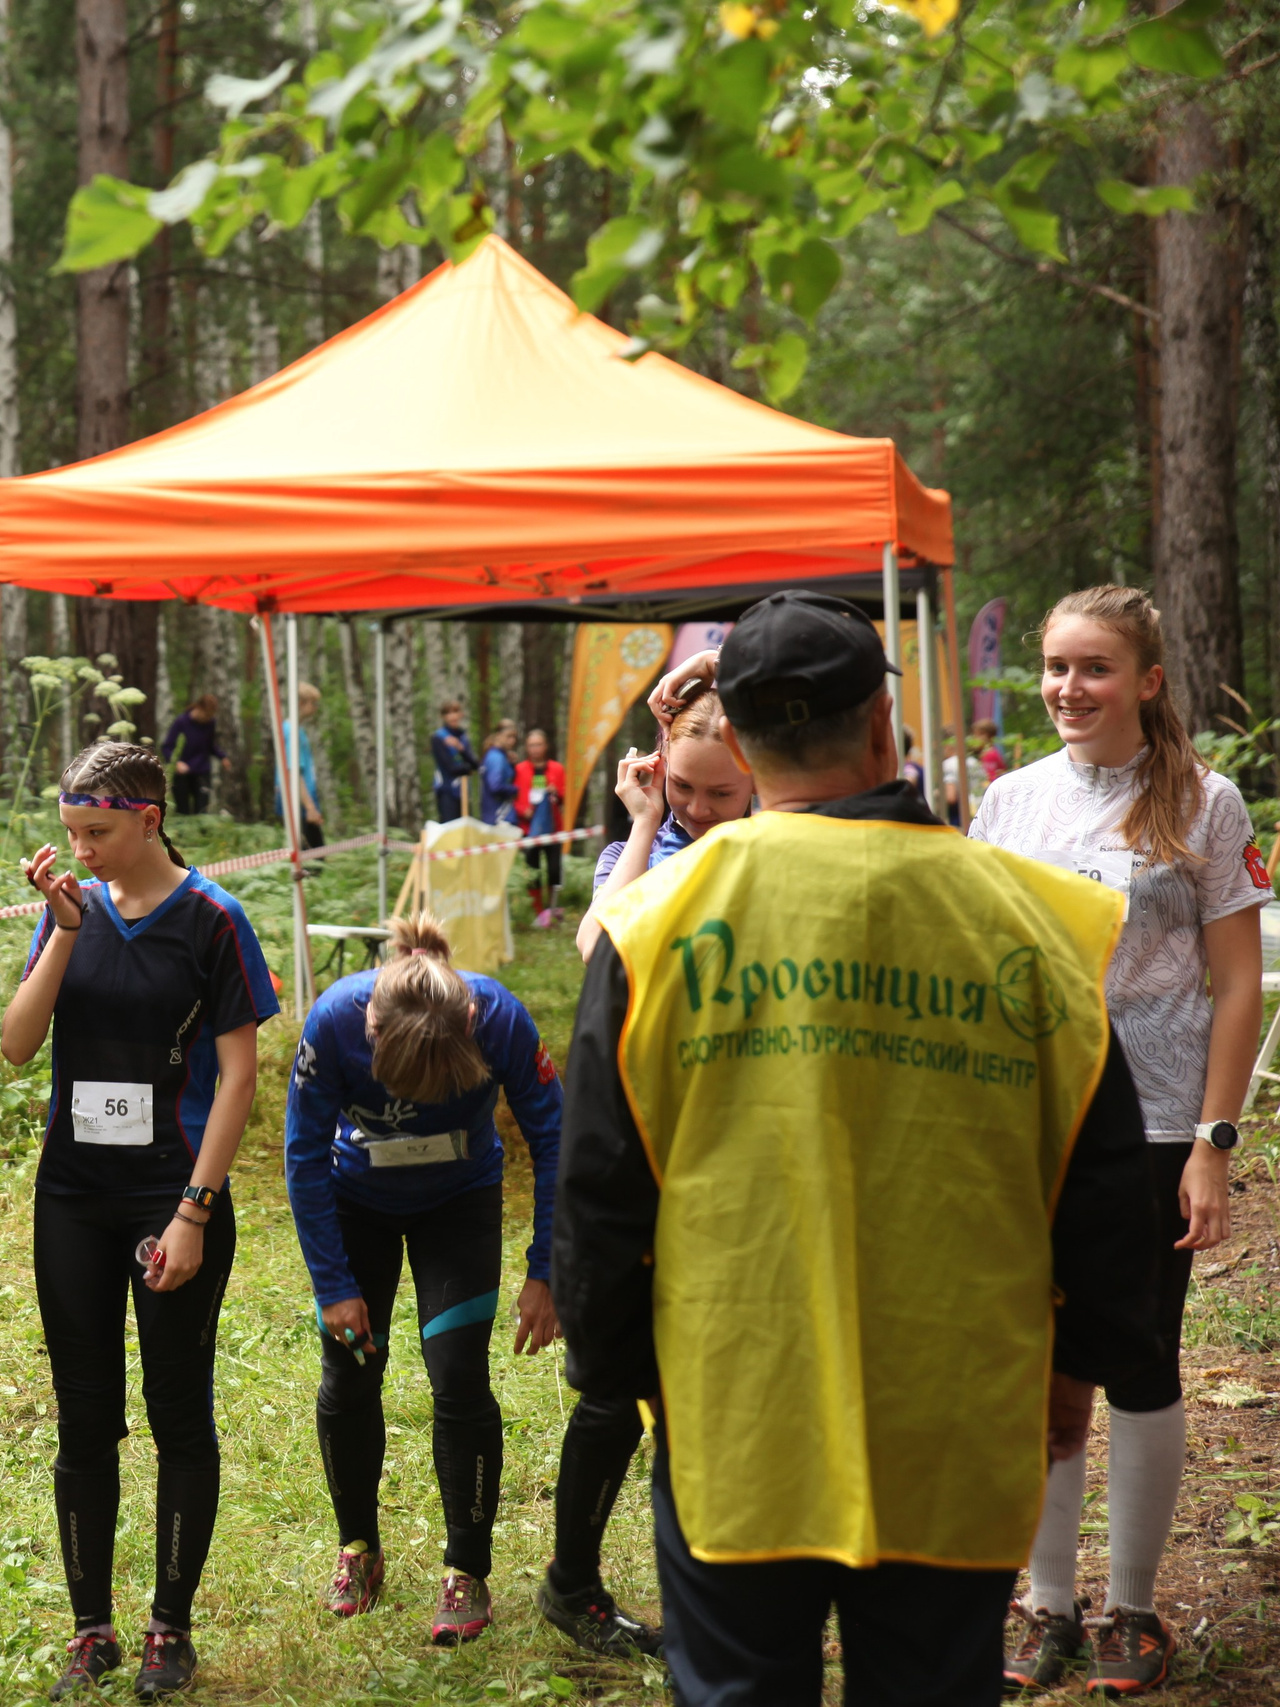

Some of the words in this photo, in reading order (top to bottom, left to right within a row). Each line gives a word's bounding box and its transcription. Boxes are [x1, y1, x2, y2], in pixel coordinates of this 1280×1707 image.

[670, 918, 986, 1023] Провинция
[677, 1024, 967, 1074] СПОРТИВНО-ТУРИСТИЧЕСКИЙ
[971, 1053, 1037, 1089] ЦЕНТР
[82, 1116, 98, 1124] Ж21
[104, 1098, 129, 1117] 56
[406, 1144, 430, 1153] 57
[475, 1455, 484, 1505] NORD
[69, 1511, 79, 1563] NORD
[172, 1511, 181, 1563] NORD
